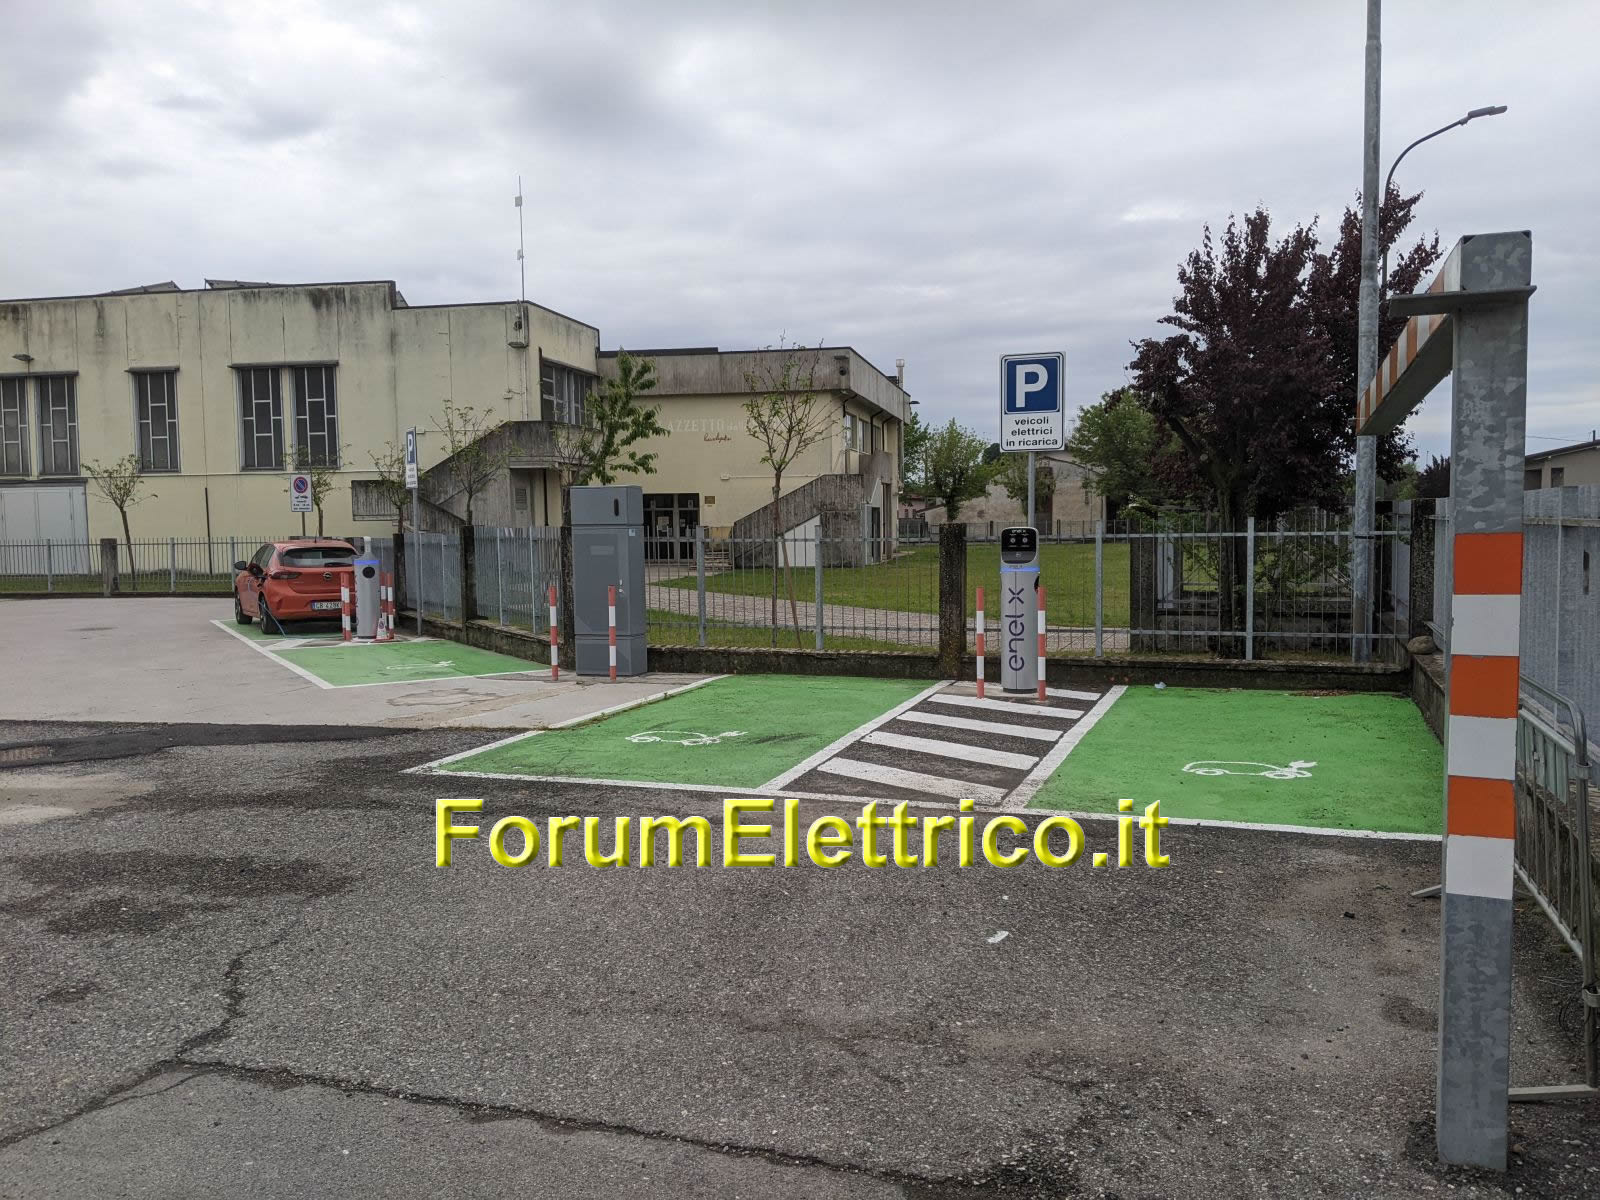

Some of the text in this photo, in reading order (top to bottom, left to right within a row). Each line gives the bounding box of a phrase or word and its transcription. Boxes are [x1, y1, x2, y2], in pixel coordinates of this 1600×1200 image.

[1015, 364, 1048, 408] P
[668, 418, 726, 432] AZZETTO
[1014, 416, 1049, 426] veicoli
[1011, 427, 1053, 436] elettrici
[407, 433, 414, 462] P
[1006, 437, 1058, 447] in ricarica
[1004, 613, 1025, 672] enel
